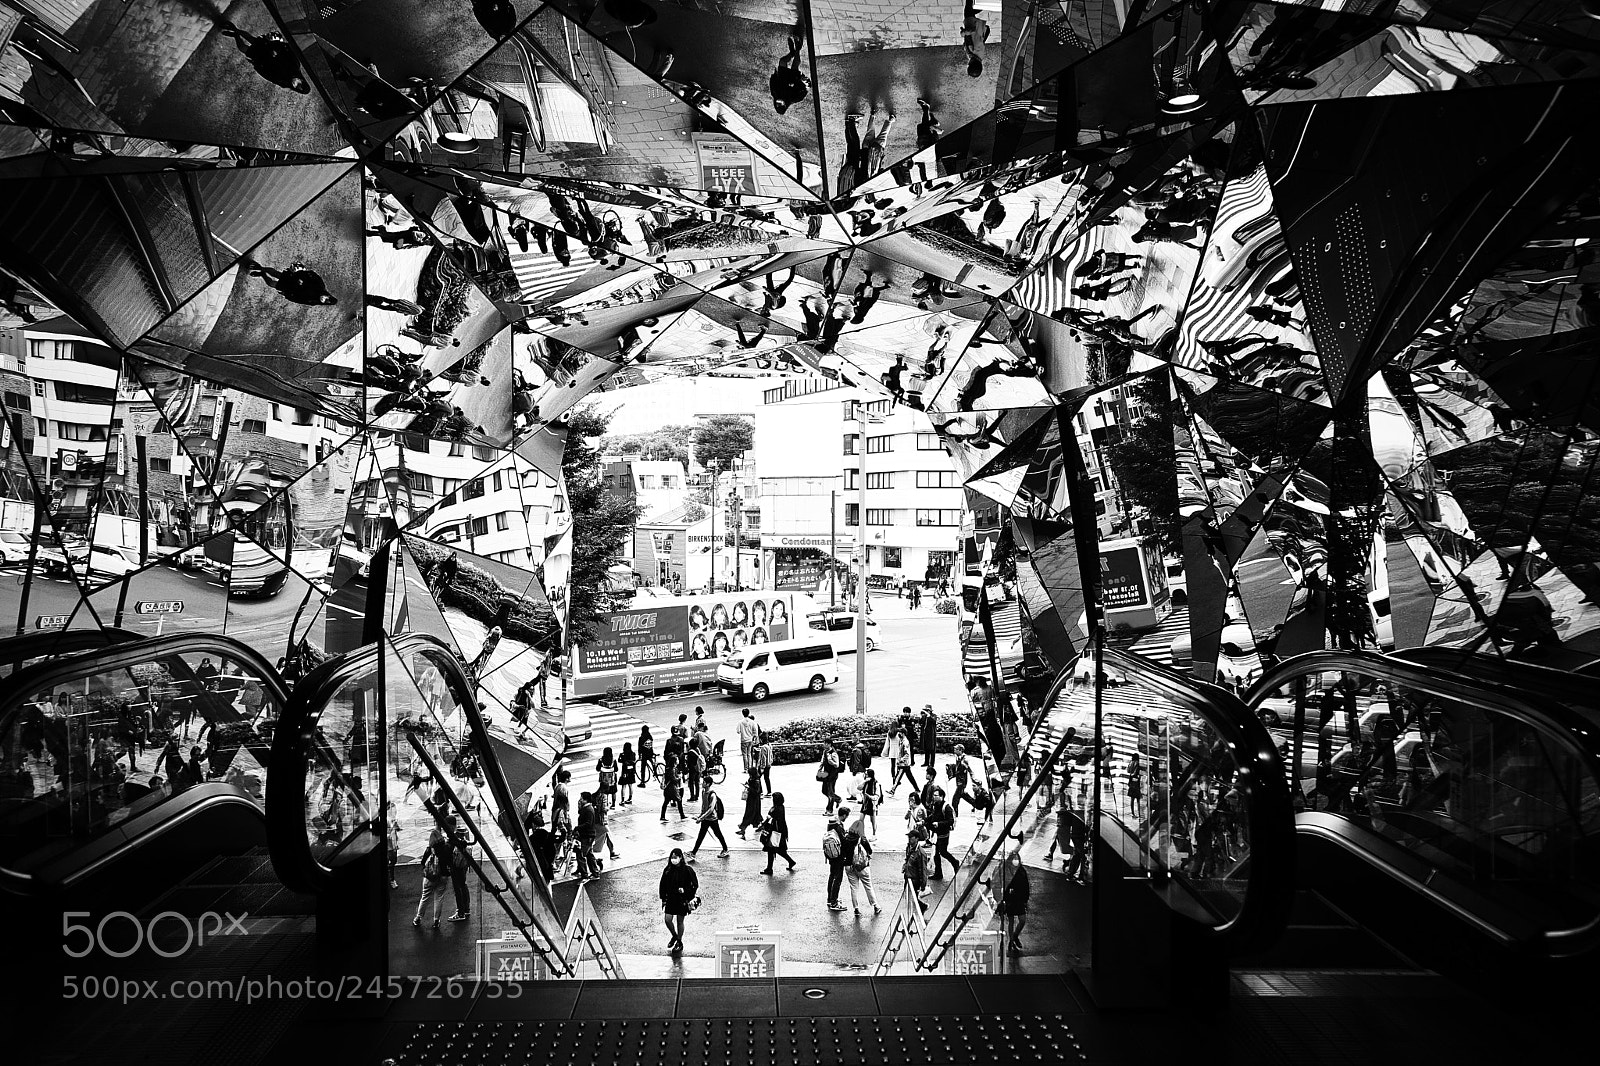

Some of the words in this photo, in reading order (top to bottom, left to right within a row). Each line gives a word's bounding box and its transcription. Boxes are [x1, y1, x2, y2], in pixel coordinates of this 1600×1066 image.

[610, 612, 658, 632] TWICE
[620, 636, 646, 645] More
[586, 649, 606, 657] 10.18
[607, 647, 626, 656] Wed.
[586, 654, 620, 664] Release!
[729, 949, 767, 964] TAX
[730, 963, 767, 978] FREE
